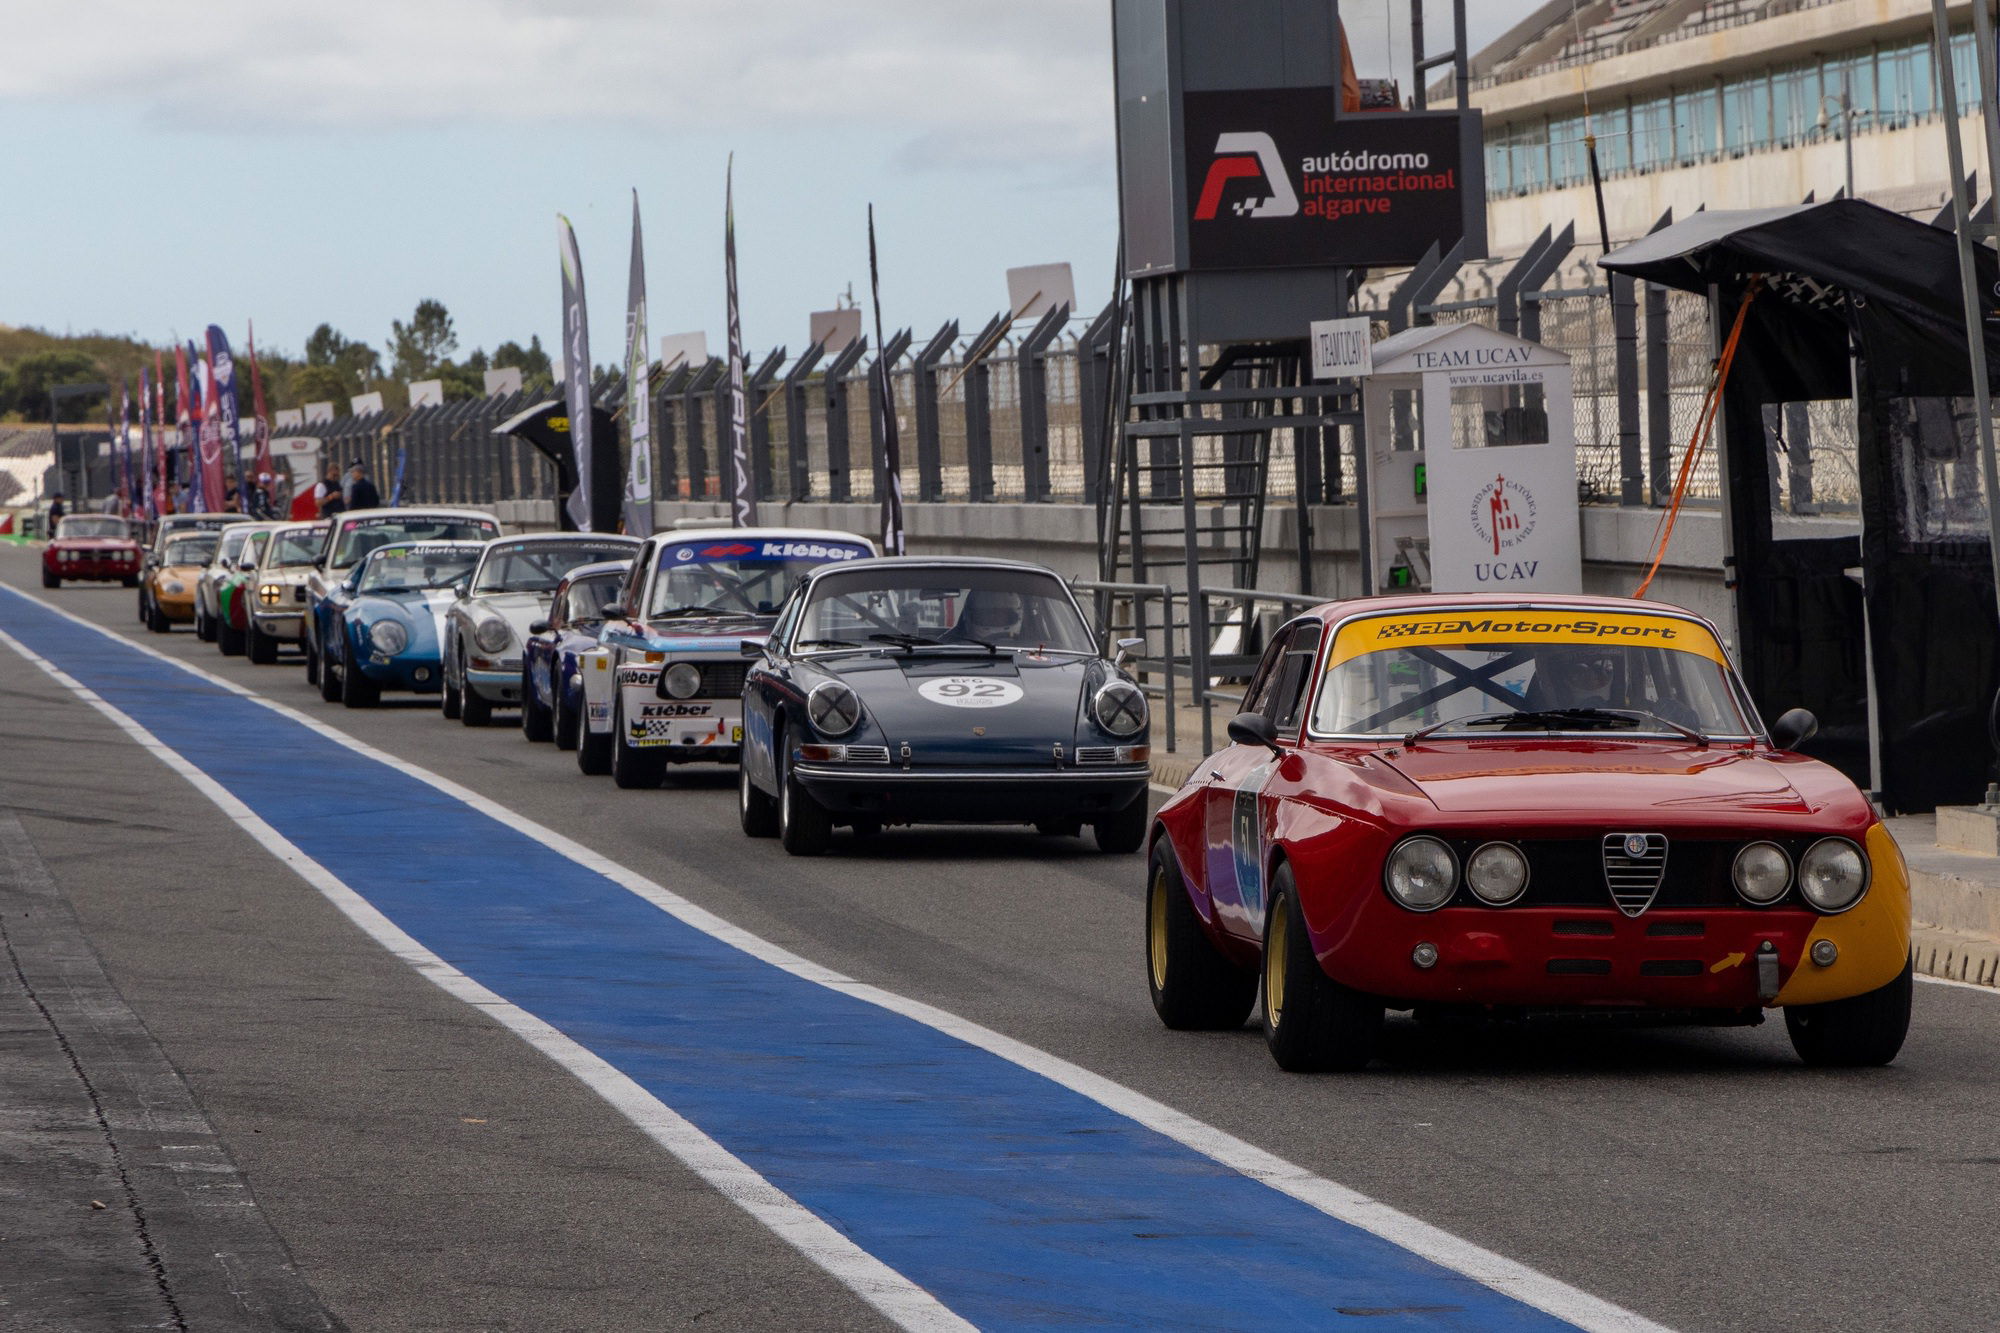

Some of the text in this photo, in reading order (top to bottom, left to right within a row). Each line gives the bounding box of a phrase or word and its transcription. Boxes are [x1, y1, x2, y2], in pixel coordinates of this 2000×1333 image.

[1302, 150, 1429, 172] autódromo
[1303, 168, 1455, 194] internacional
[1304, 193, 1391, 220] algarve
[1413, 346, 1532, 368] TEAM UCAV
[1449, 369, 1544, 385] www.ucavila.es
[1471, 483, 1494, 543] UNIVERSIDAD
[1502, 540, 1514, 548] DE
[405, 546, 457, 555] Alberto
[1474, 561, 1538, 581] UCAV
[938, 684, 1005, 697] 92
